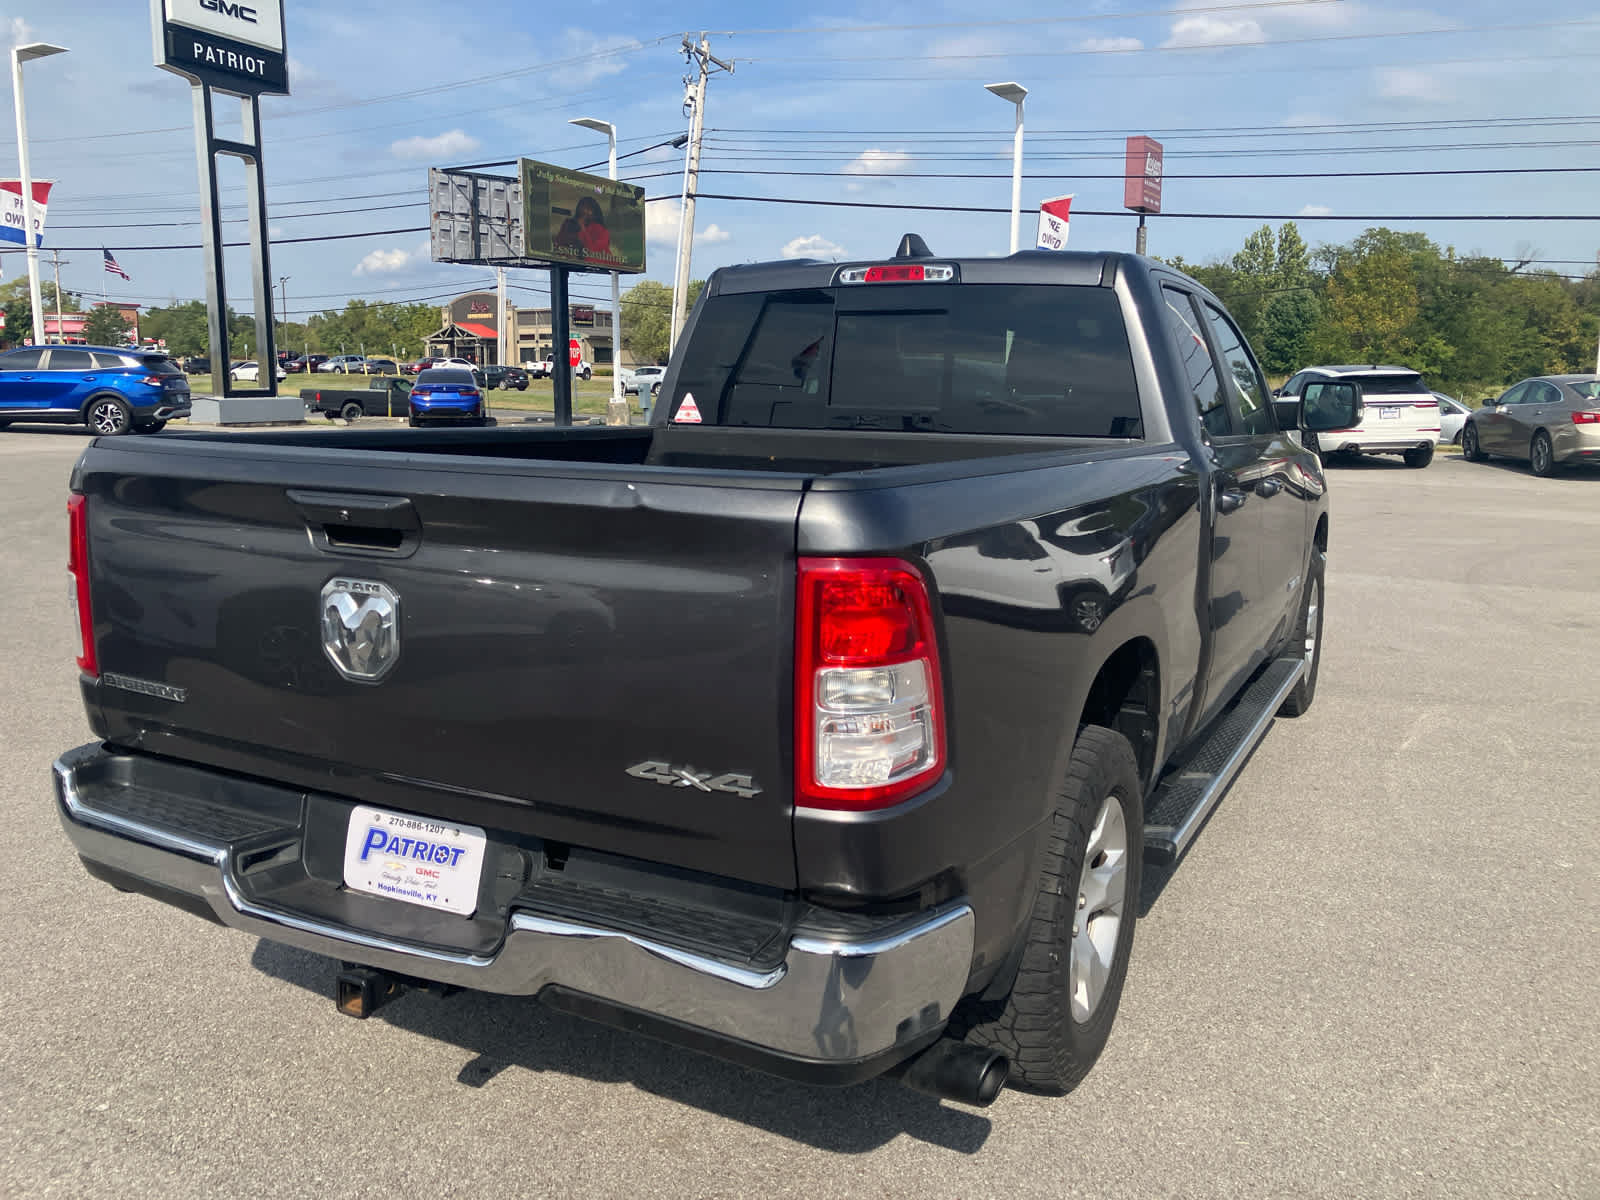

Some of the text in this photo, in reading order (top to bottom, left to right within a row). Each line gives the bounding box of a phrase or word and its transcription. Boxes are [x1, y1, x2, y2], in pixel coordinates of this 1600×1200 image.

[199, 0, 257, 24] GMC
[193, 42, 266, 76] PATRIOT
[569, 347, 581, 359] TOP
[334, 580, 381, 592] RAM
[388, 817, 446, 834] 270-886-1207
[415, 867, 440, 879] GMC
[377, 882, 437, 902] Hopkinsville, KY
